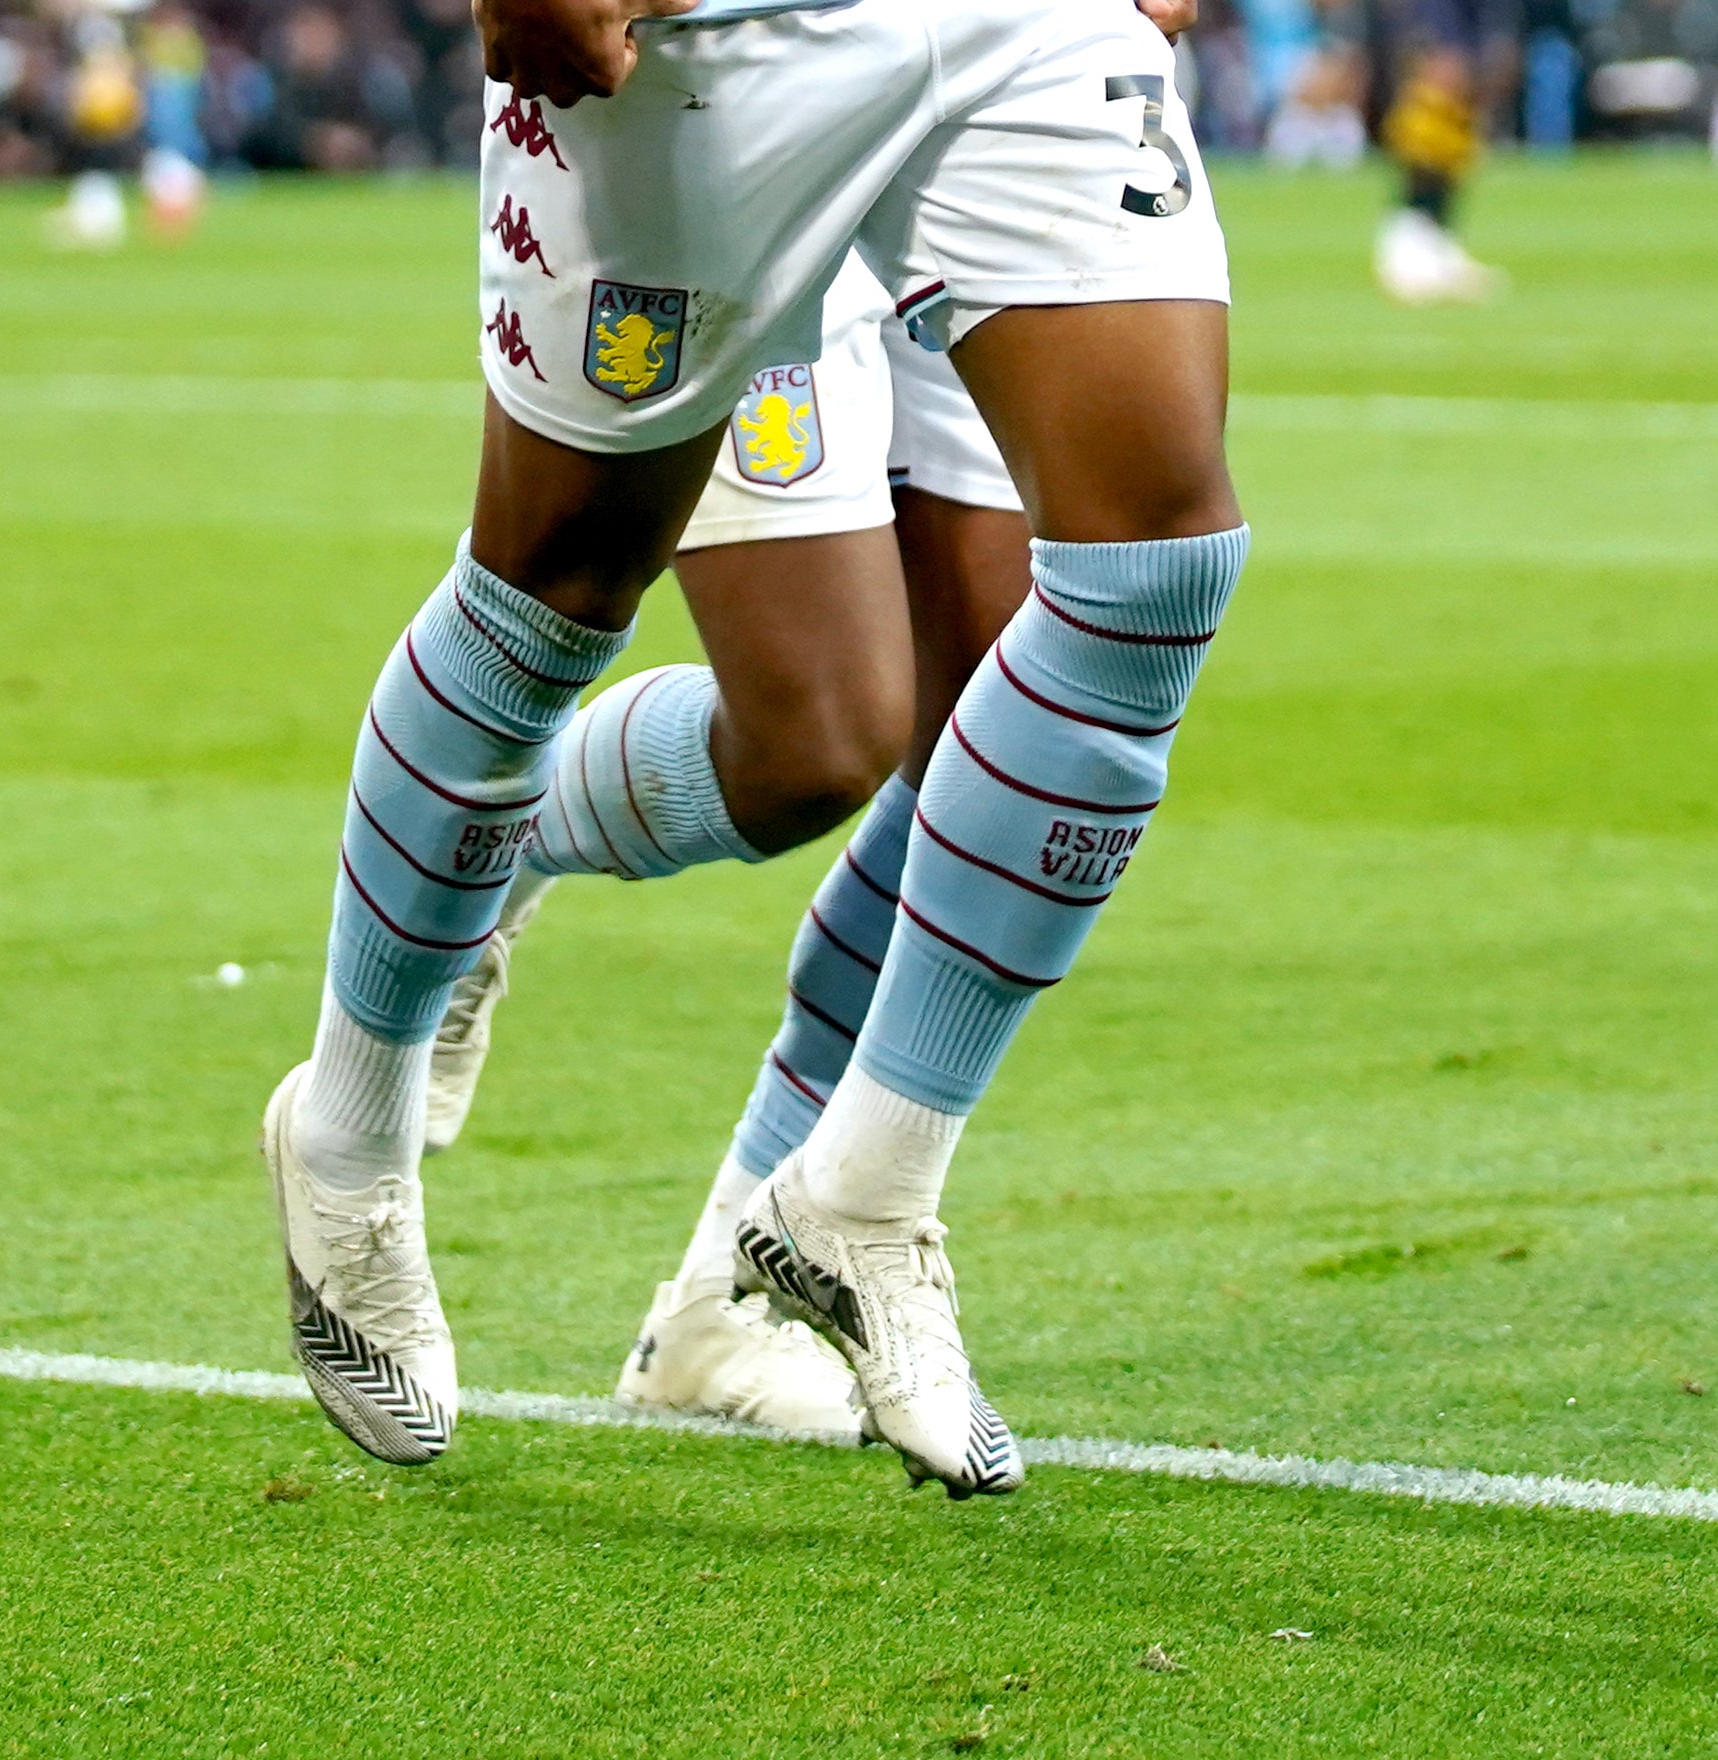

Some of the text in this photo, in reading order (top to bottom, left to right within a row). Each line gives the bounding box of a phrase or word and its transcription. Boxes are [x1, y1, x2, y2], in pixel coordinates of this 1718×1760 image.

[597, 288, 680, 316] AVFC
[744, 365, 808, 395] VFC
[1046, 820, 1144, 856] ASTON
[1041, 846, 1130, 886] VILLA
